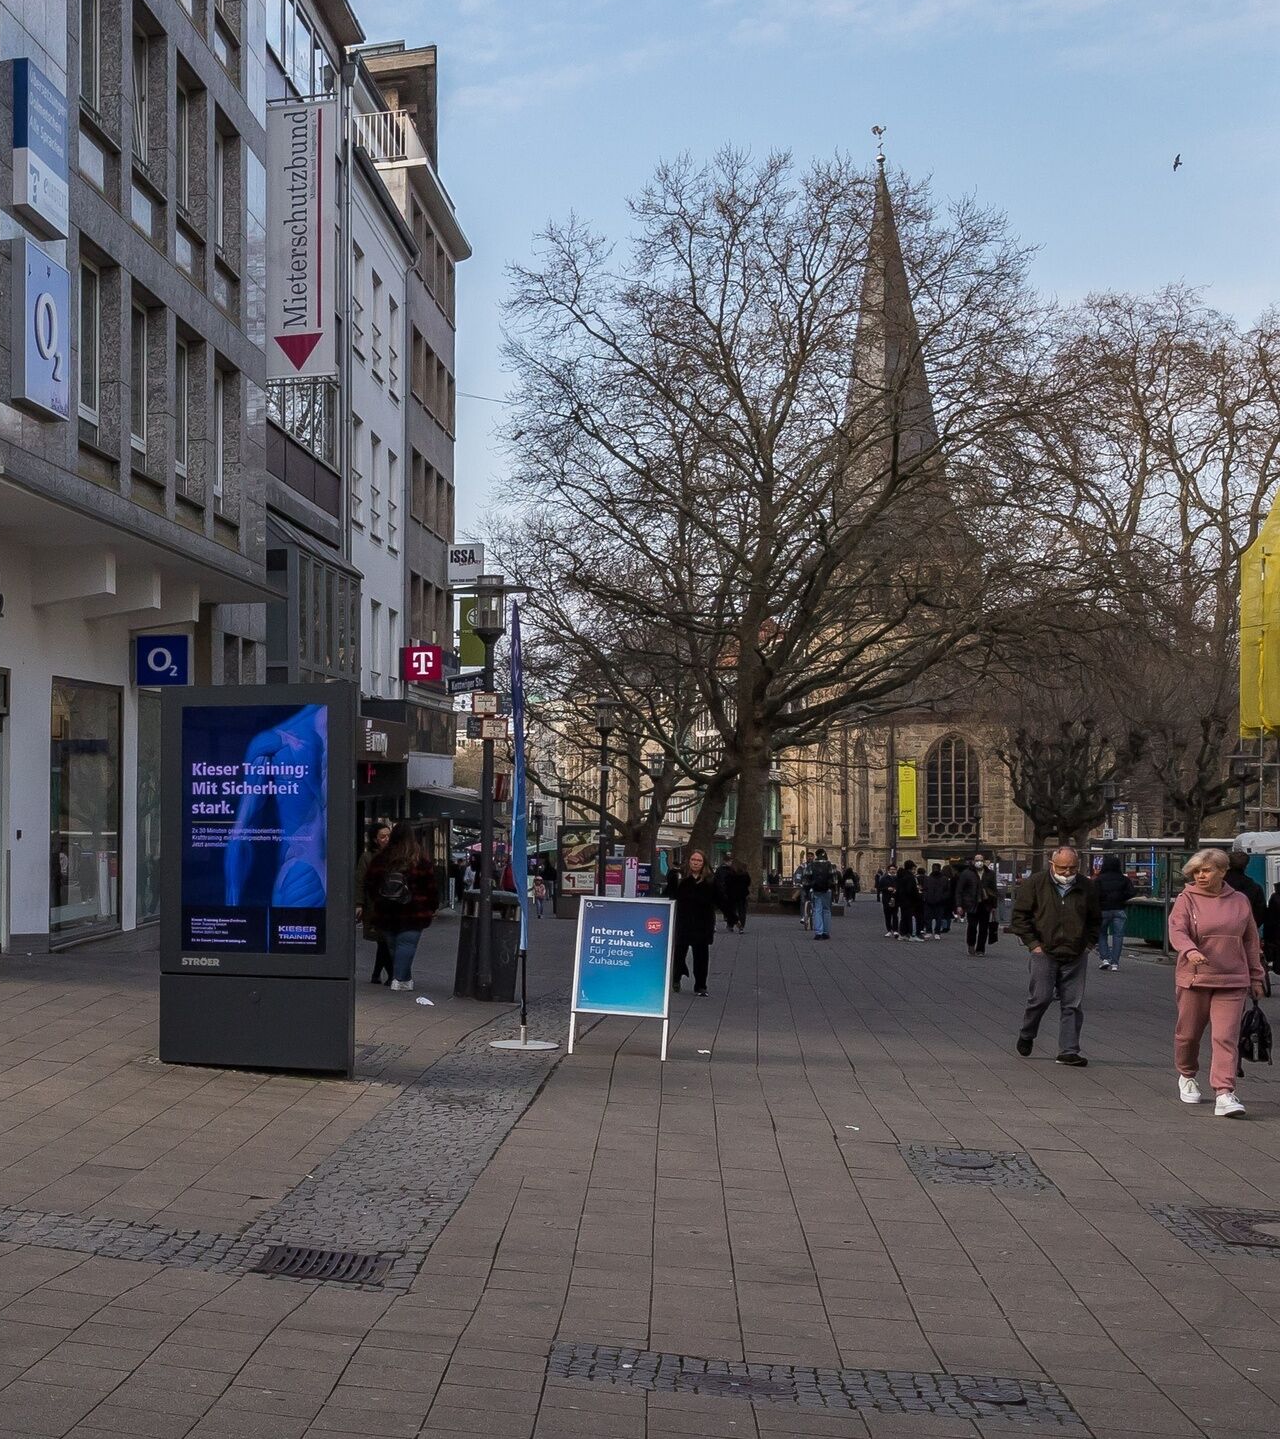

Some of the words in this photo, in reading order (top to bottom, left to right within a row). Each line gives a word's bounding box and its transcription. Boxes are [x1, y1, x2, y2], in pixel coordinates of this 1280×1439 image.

[282, 109, 308, 330] Mieterschutzbund
[450, 549, 475, 564] ISSA
[147, 647, 178, 677] O2
[192, 762, 239, 776] Kieser
[241, 762, 309, 779] Training:
[192, 781, 218, 795] Mit
[221, 781, 299, 795] Sicherheit
[192, 800, 235, 814] stark.
[278, 925, 317, 933] KIESER
[591, 926, 635, 937] Internet
[590, 936, 606, 945] für
[608, 937, 653, 948] zuhause.
[589, 946, 605, 954] Für
[607, 947, 634, 957] jedes
[182, 957, 220, 967] STRÖER
